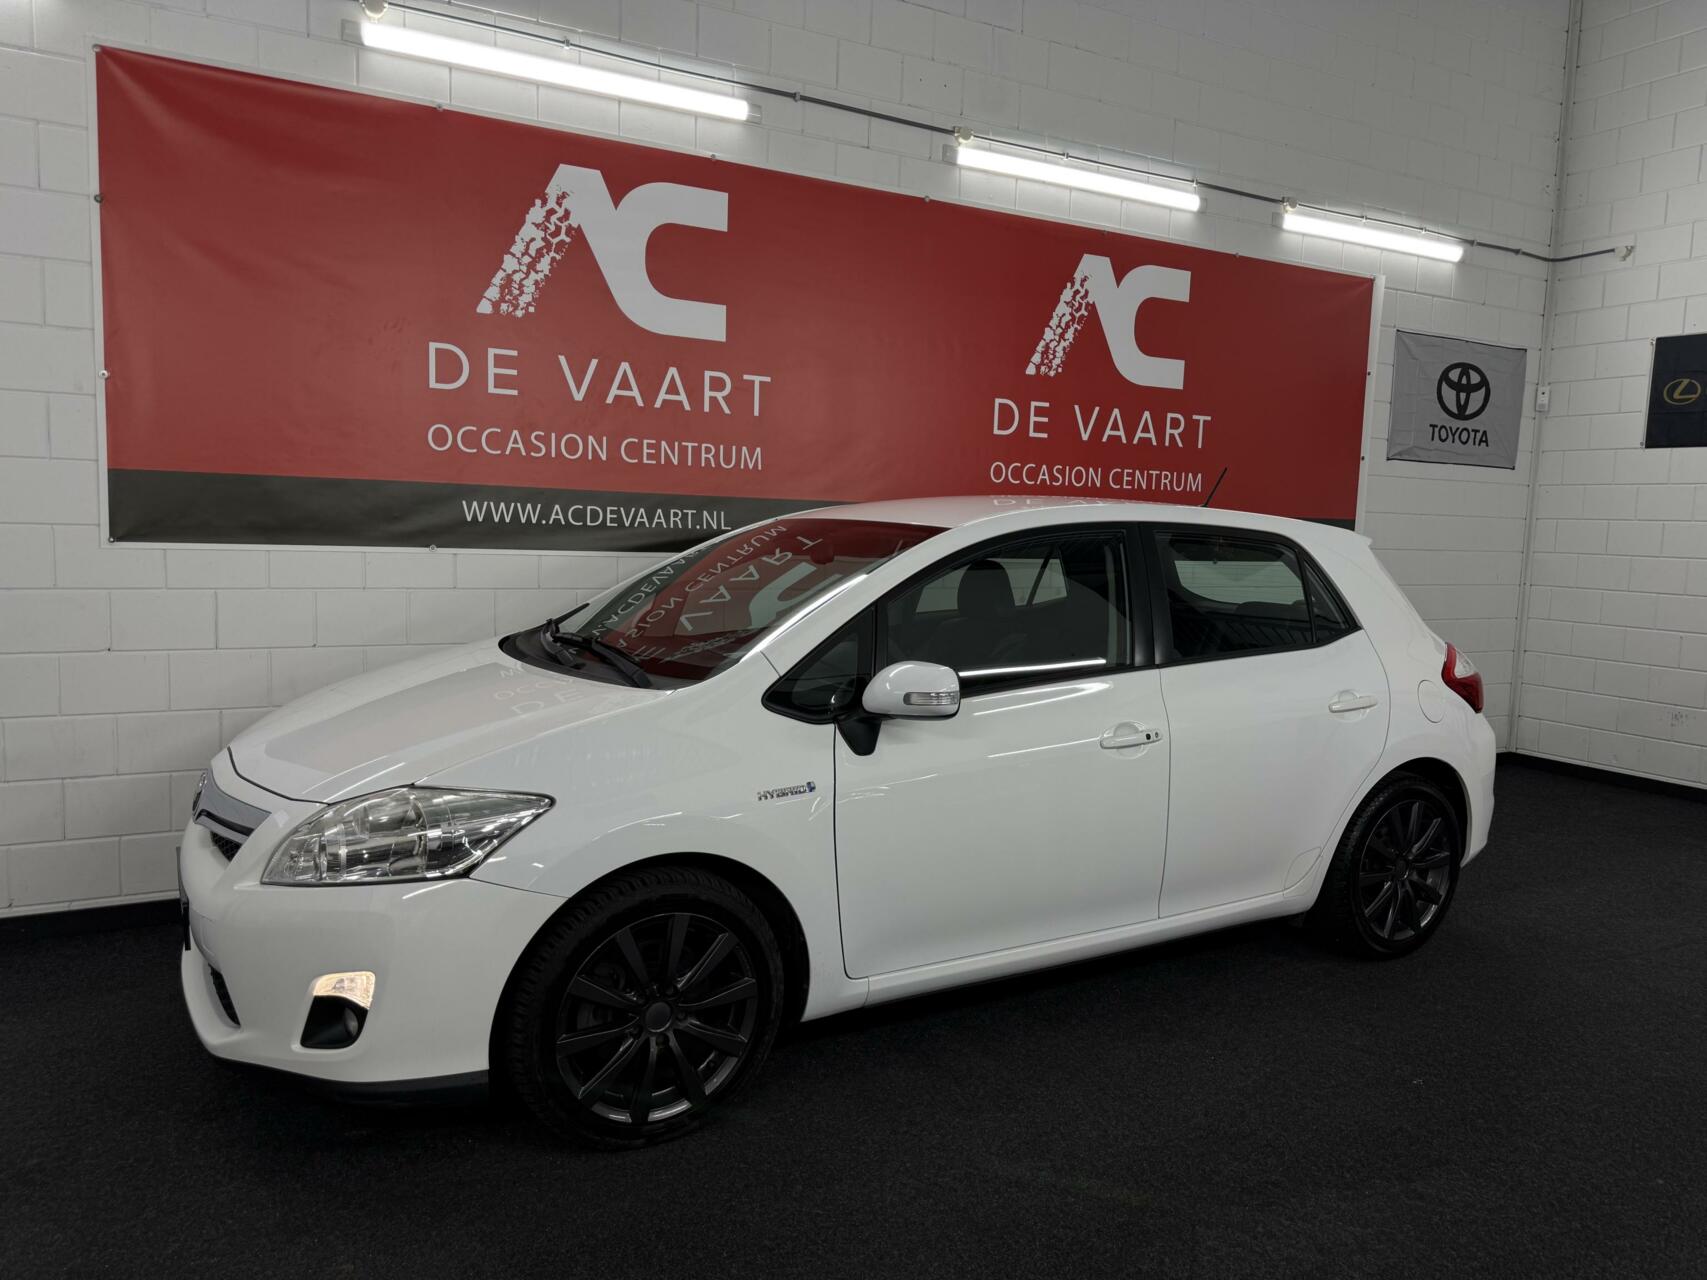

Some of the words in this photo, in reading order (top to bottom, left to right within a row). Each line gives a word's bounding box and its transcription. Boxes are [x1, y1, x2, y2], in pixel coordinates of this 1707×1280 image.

[476, 164, 729, 342] AC
[1026, 253, 1192, 390] AC
[428, 341, 519, 396] DE
[557, 354, 772, 417] VAART
[427, 423, 607, 461] OCCASION
[620, 437, 762, 470] CENTRUM
[992, 397, 1050, 439] DE
[1074, 404, 1212, 449] VAART
[1429, 423, 1489, 447] TOYOTA
[990, 461, 1102, 488] OCCASION
[1109, 468, 1202, 492] CENTRUM
[462, 500, 732, 531] WWW.ACDEVAART.NL
